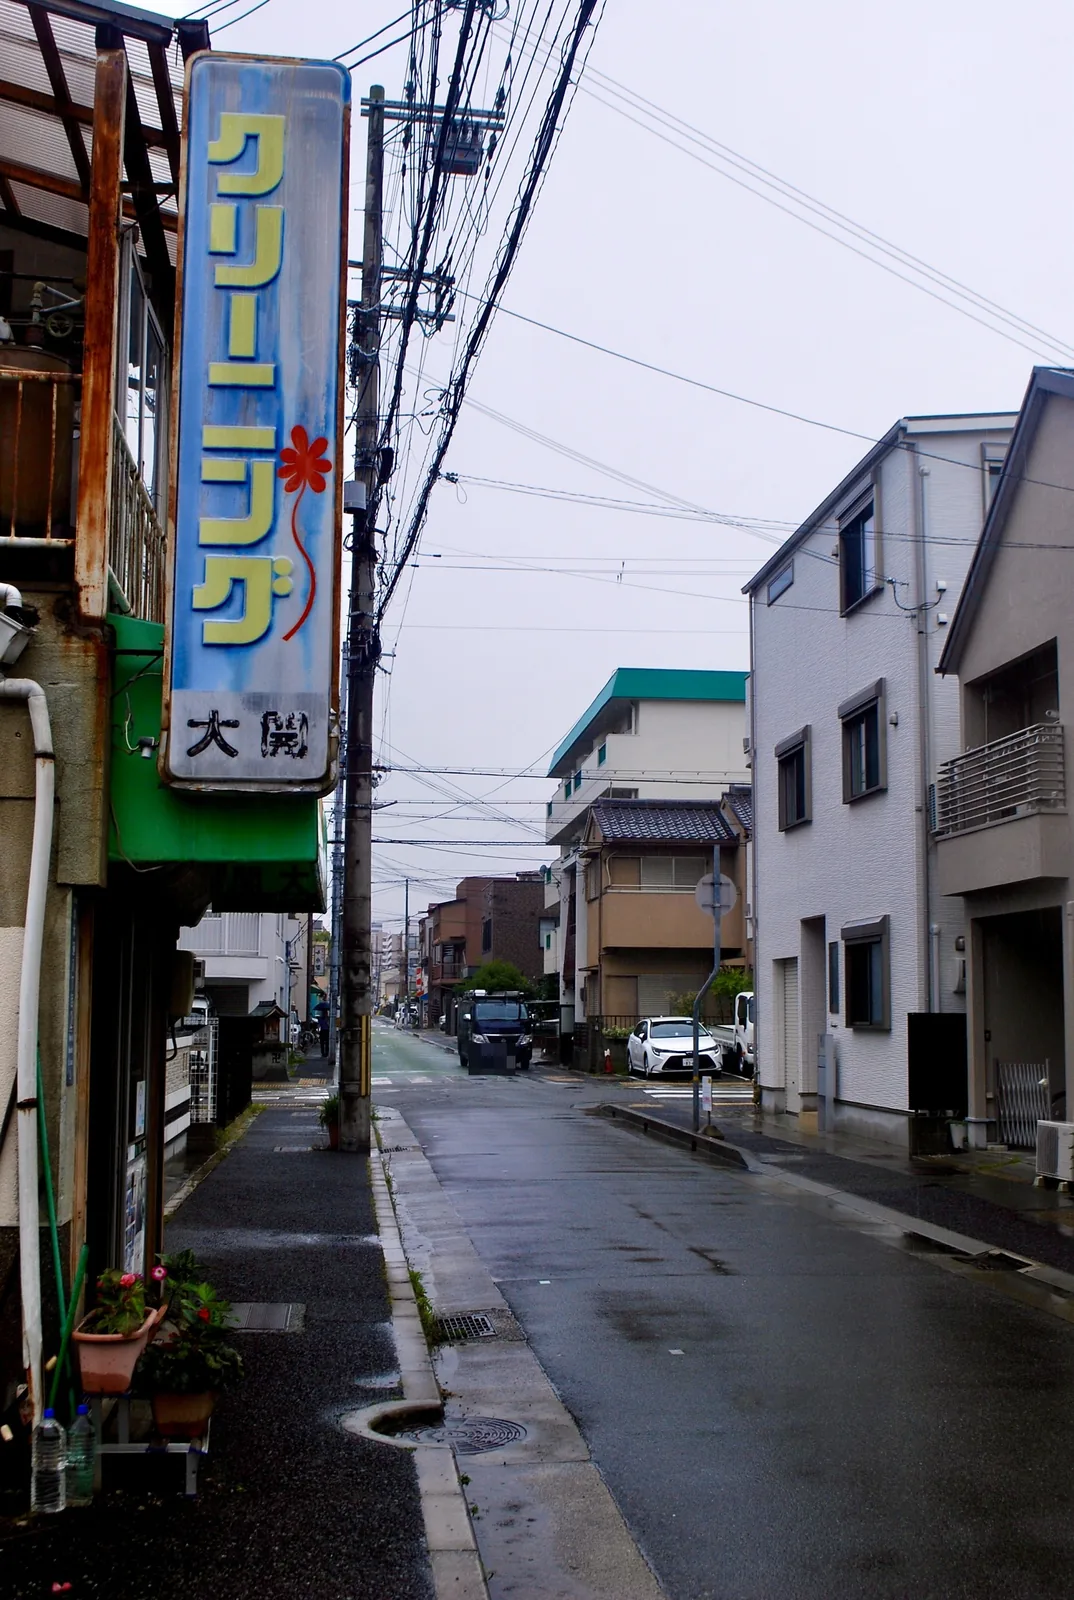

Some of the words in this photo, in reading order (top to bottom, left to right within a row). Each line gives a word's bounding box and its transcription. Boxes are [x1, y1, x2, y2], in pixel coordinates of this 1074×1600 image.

[192, 113, 294, 645] クリーニング
